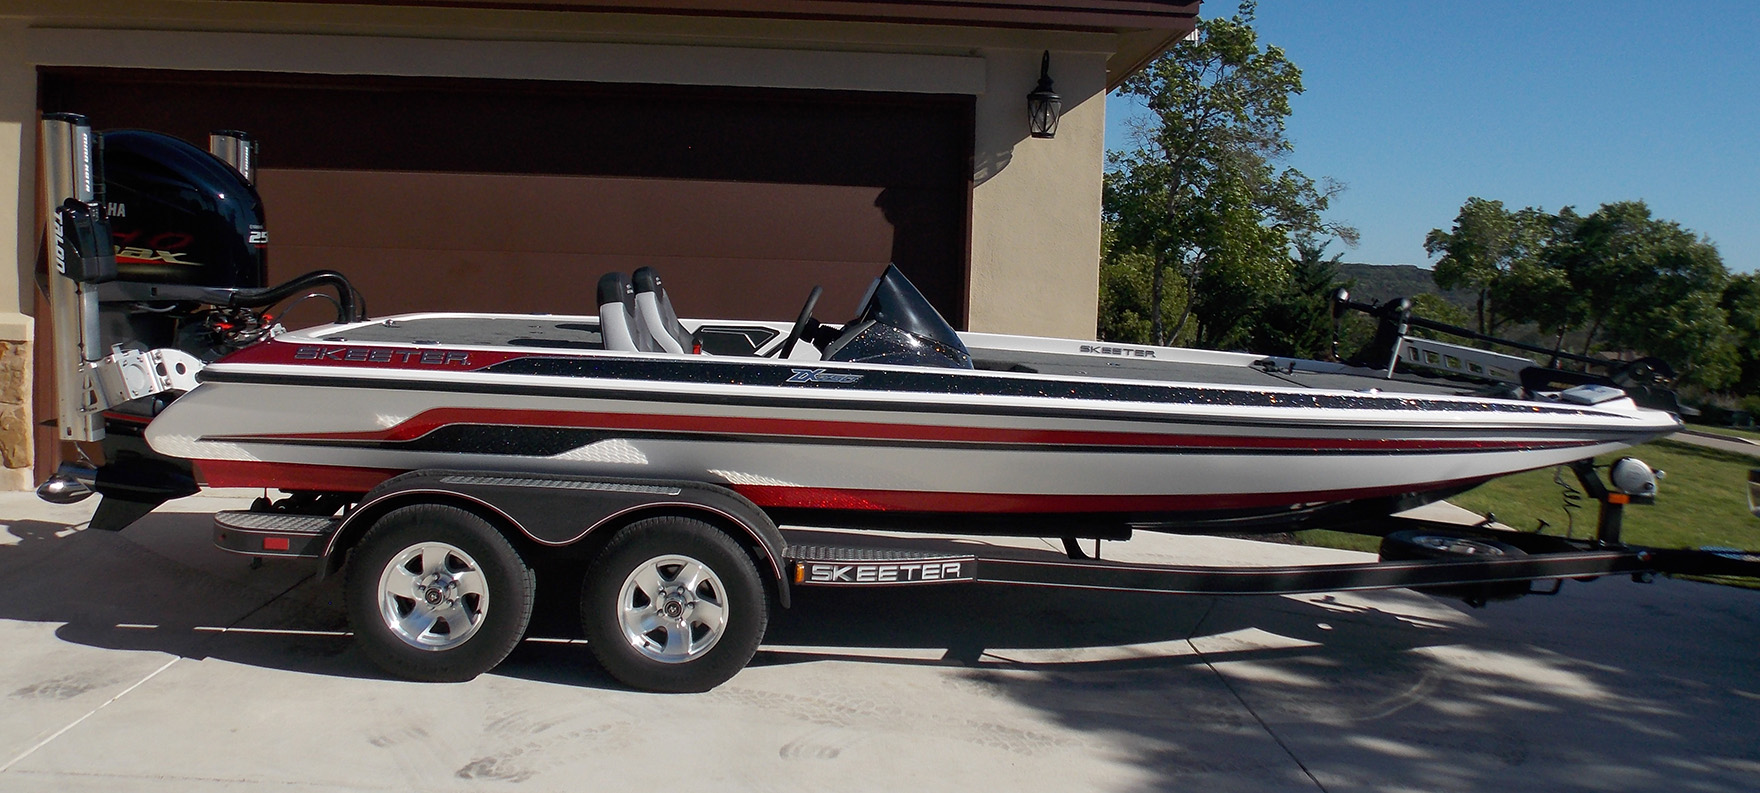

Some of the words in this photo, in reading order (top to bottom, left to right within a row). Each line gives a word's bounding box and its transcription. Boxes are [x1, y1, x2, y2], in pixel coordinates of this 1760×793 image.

[294, 346, 471, 366] SKEETER
[1079, 344, 1156, 358] SKEETER
[811, 562, 962, 582] SKEETER
